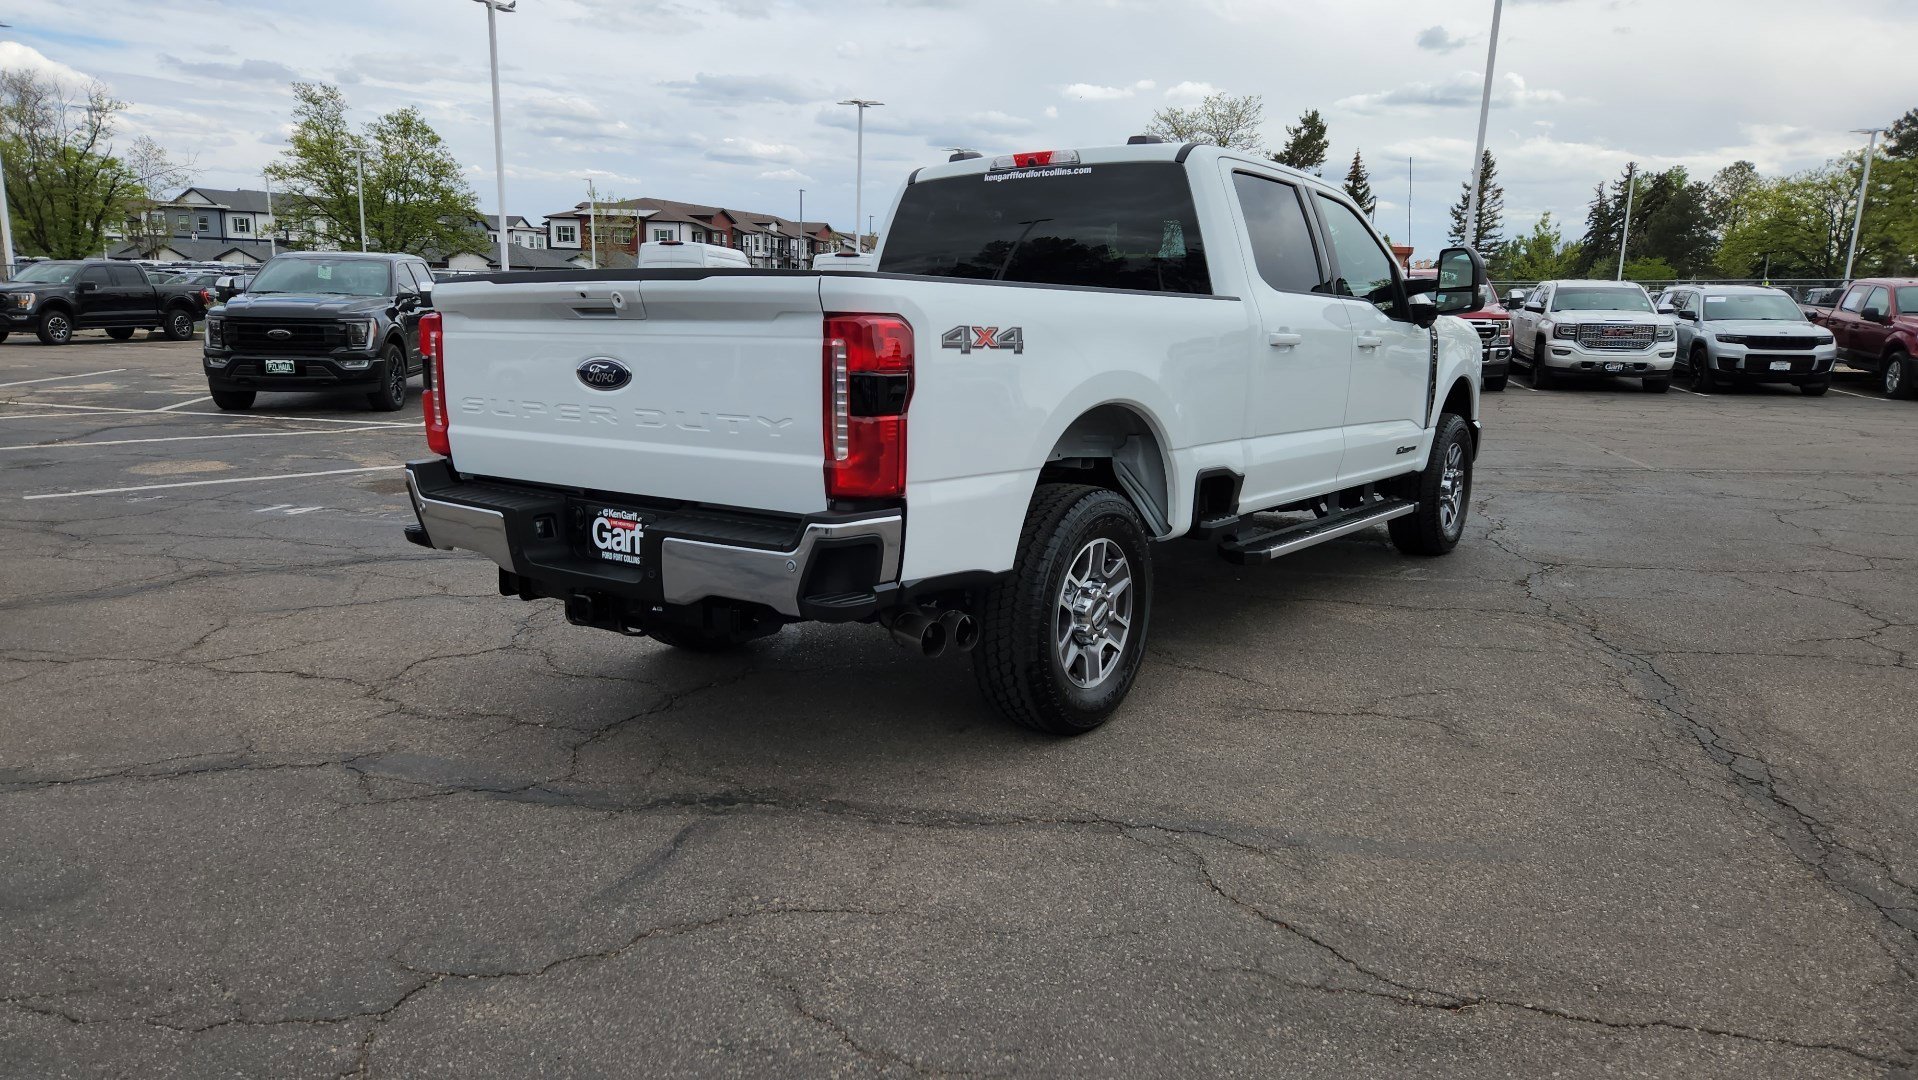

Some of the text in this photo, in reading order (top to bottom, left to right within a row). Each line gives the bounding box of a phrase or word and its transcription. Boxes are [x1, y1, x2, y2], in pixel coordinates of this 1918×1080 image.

[984, 166, 1092, 182] kengarfffordfortcollins.com
[586, 363, 618, 382] Ford
[462, 397, 793, 437] SUPER DUTY
[592, 516, 650, 555] Garf
